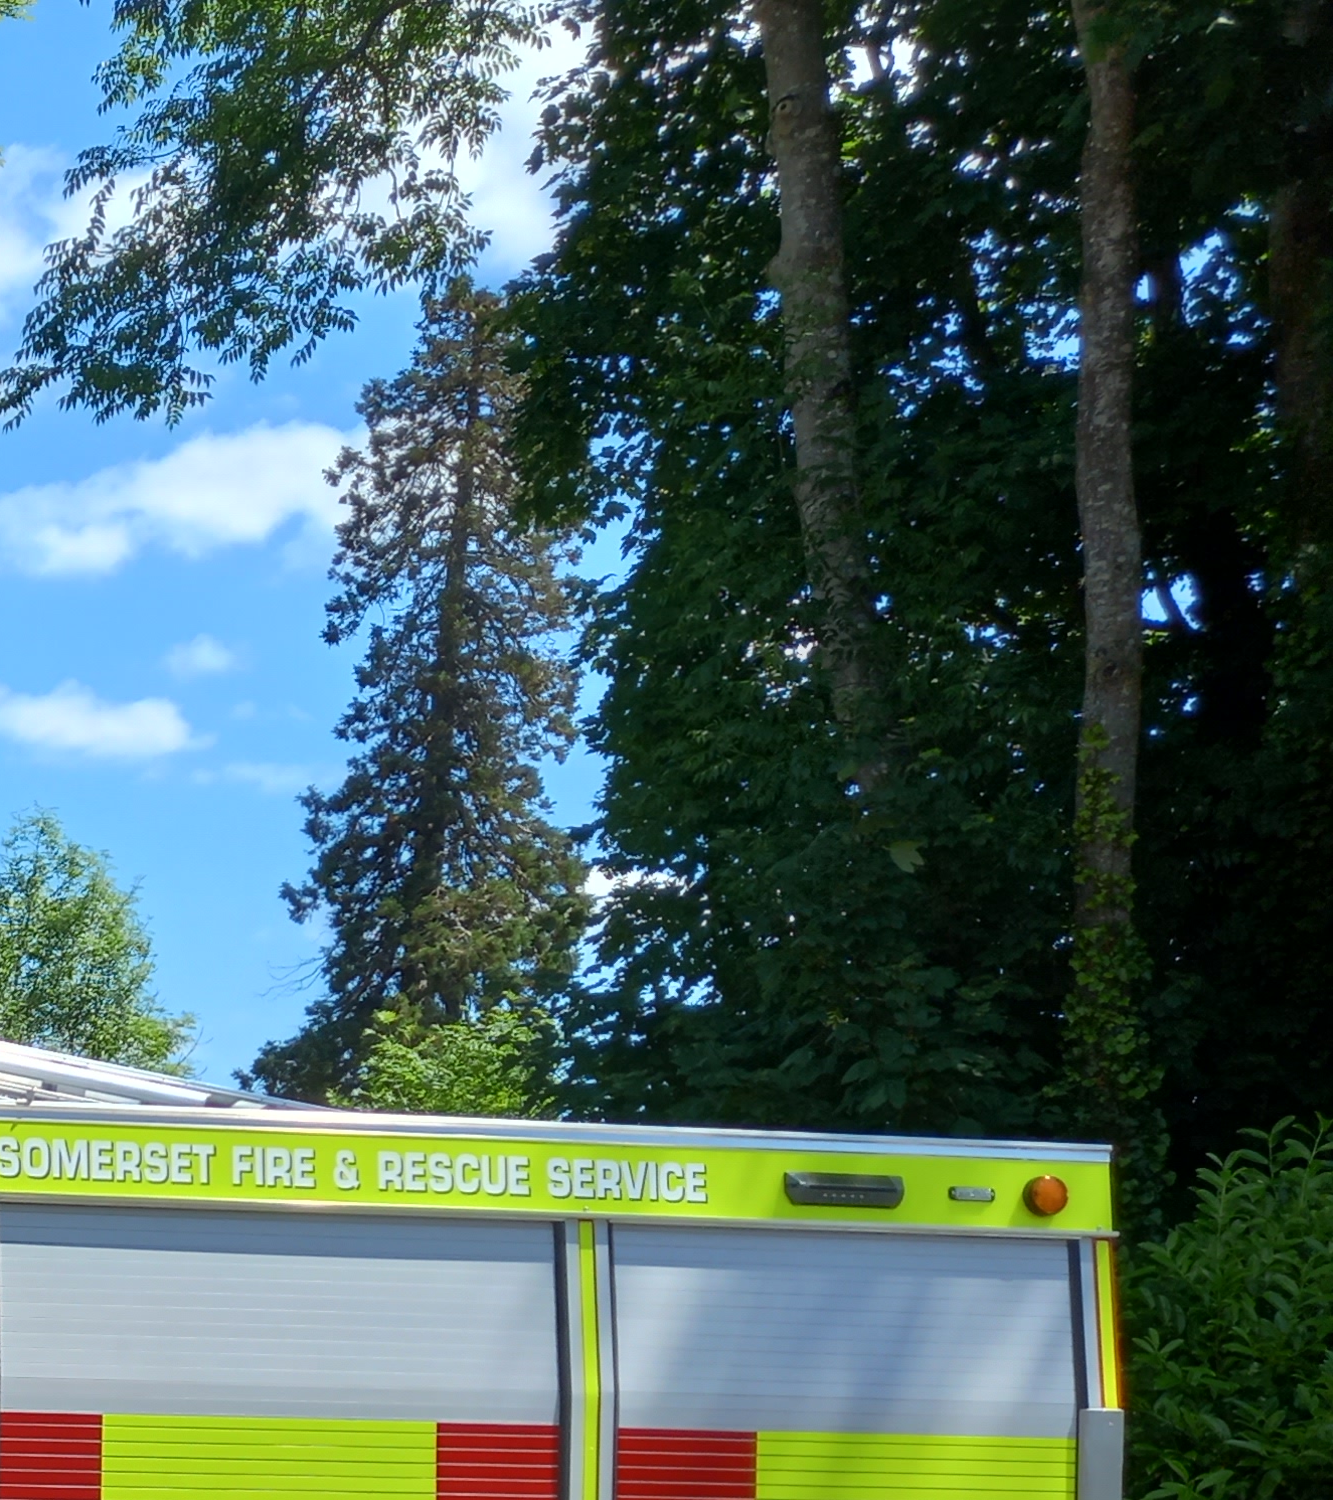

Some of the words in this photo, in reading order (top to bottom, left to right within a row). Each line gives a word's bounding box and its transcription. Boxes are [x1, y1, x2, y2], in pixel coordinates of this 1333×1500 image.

[232, 1145, 317, 1190] FIRE
[333, 1149, 362, 1191] &
[377, 1151, 532, 1199] RESCUE
[546, 1157, 709, 1204] SERVICE
